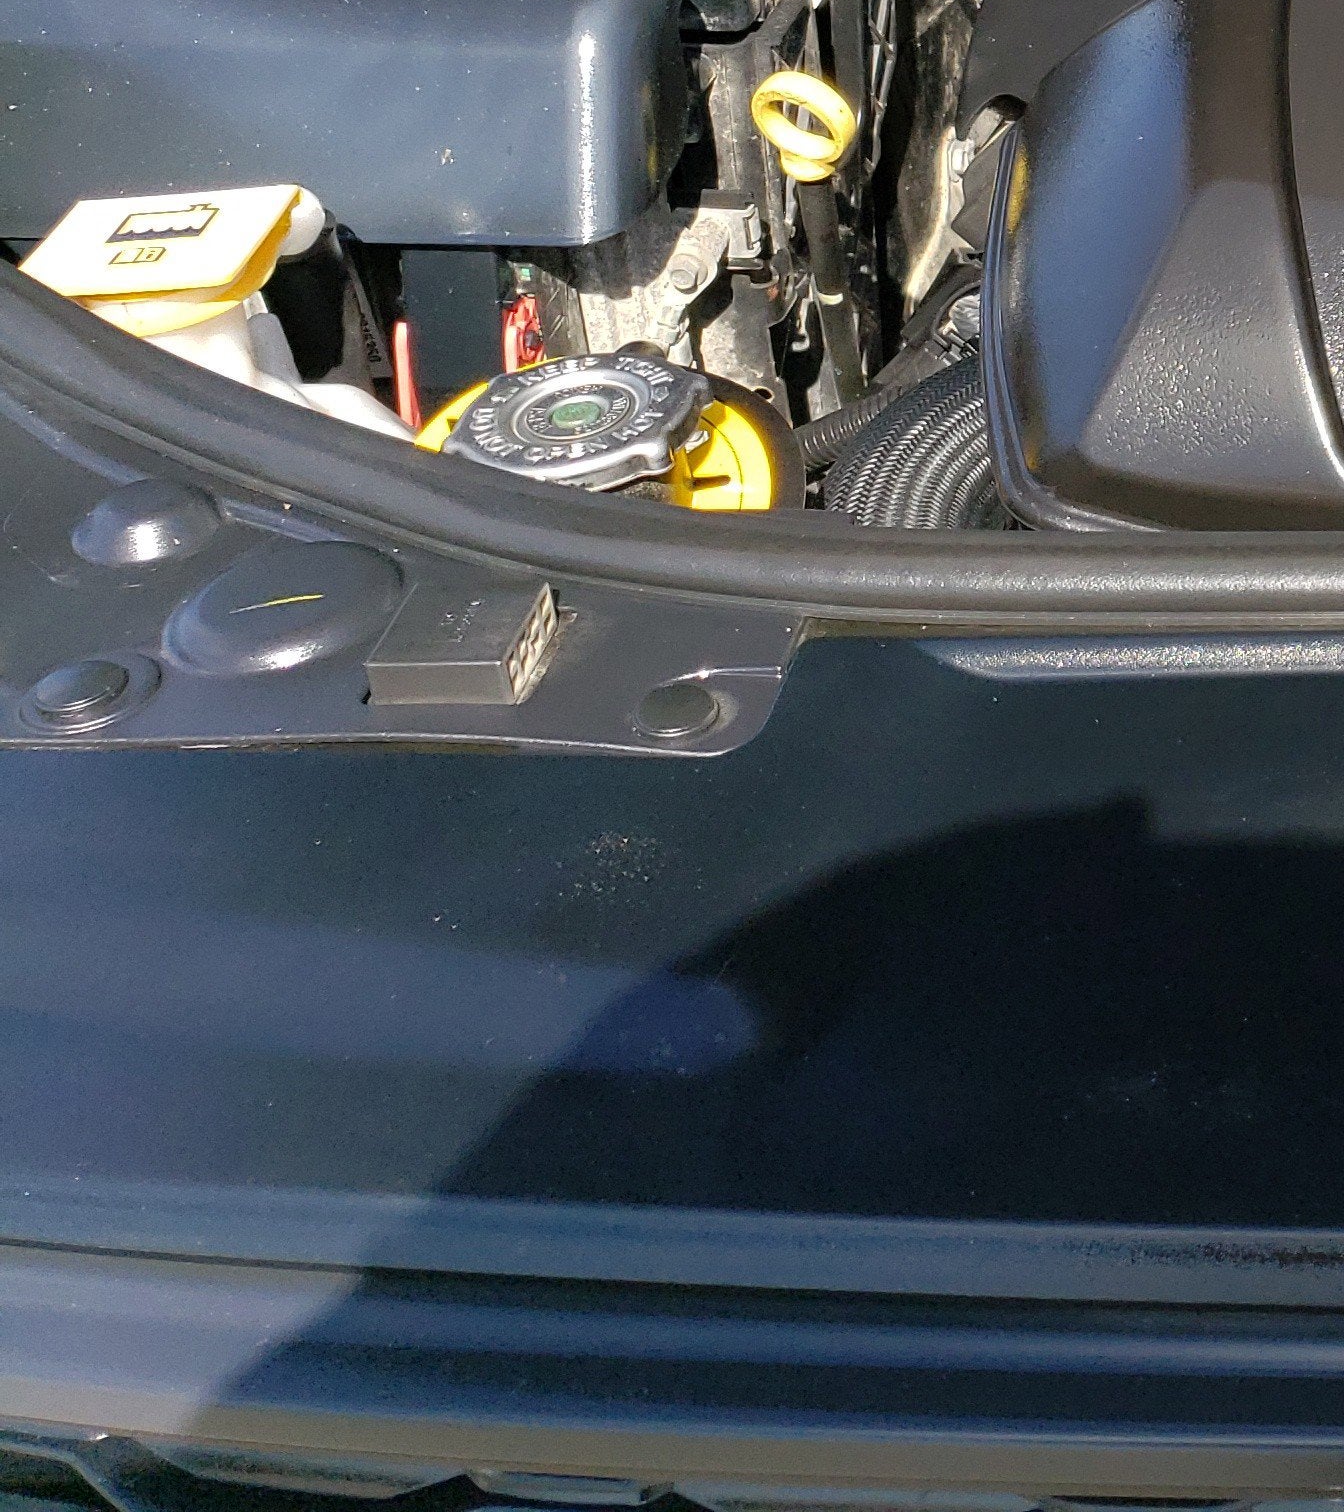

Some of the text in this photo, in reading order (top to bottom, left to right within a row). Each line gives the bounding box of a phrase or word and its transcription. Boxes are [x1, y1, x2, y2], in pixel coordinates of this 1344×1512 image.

[517, 356, 675, 386] KEEP TIGHT
[611, 407, 664, 442] HOT
